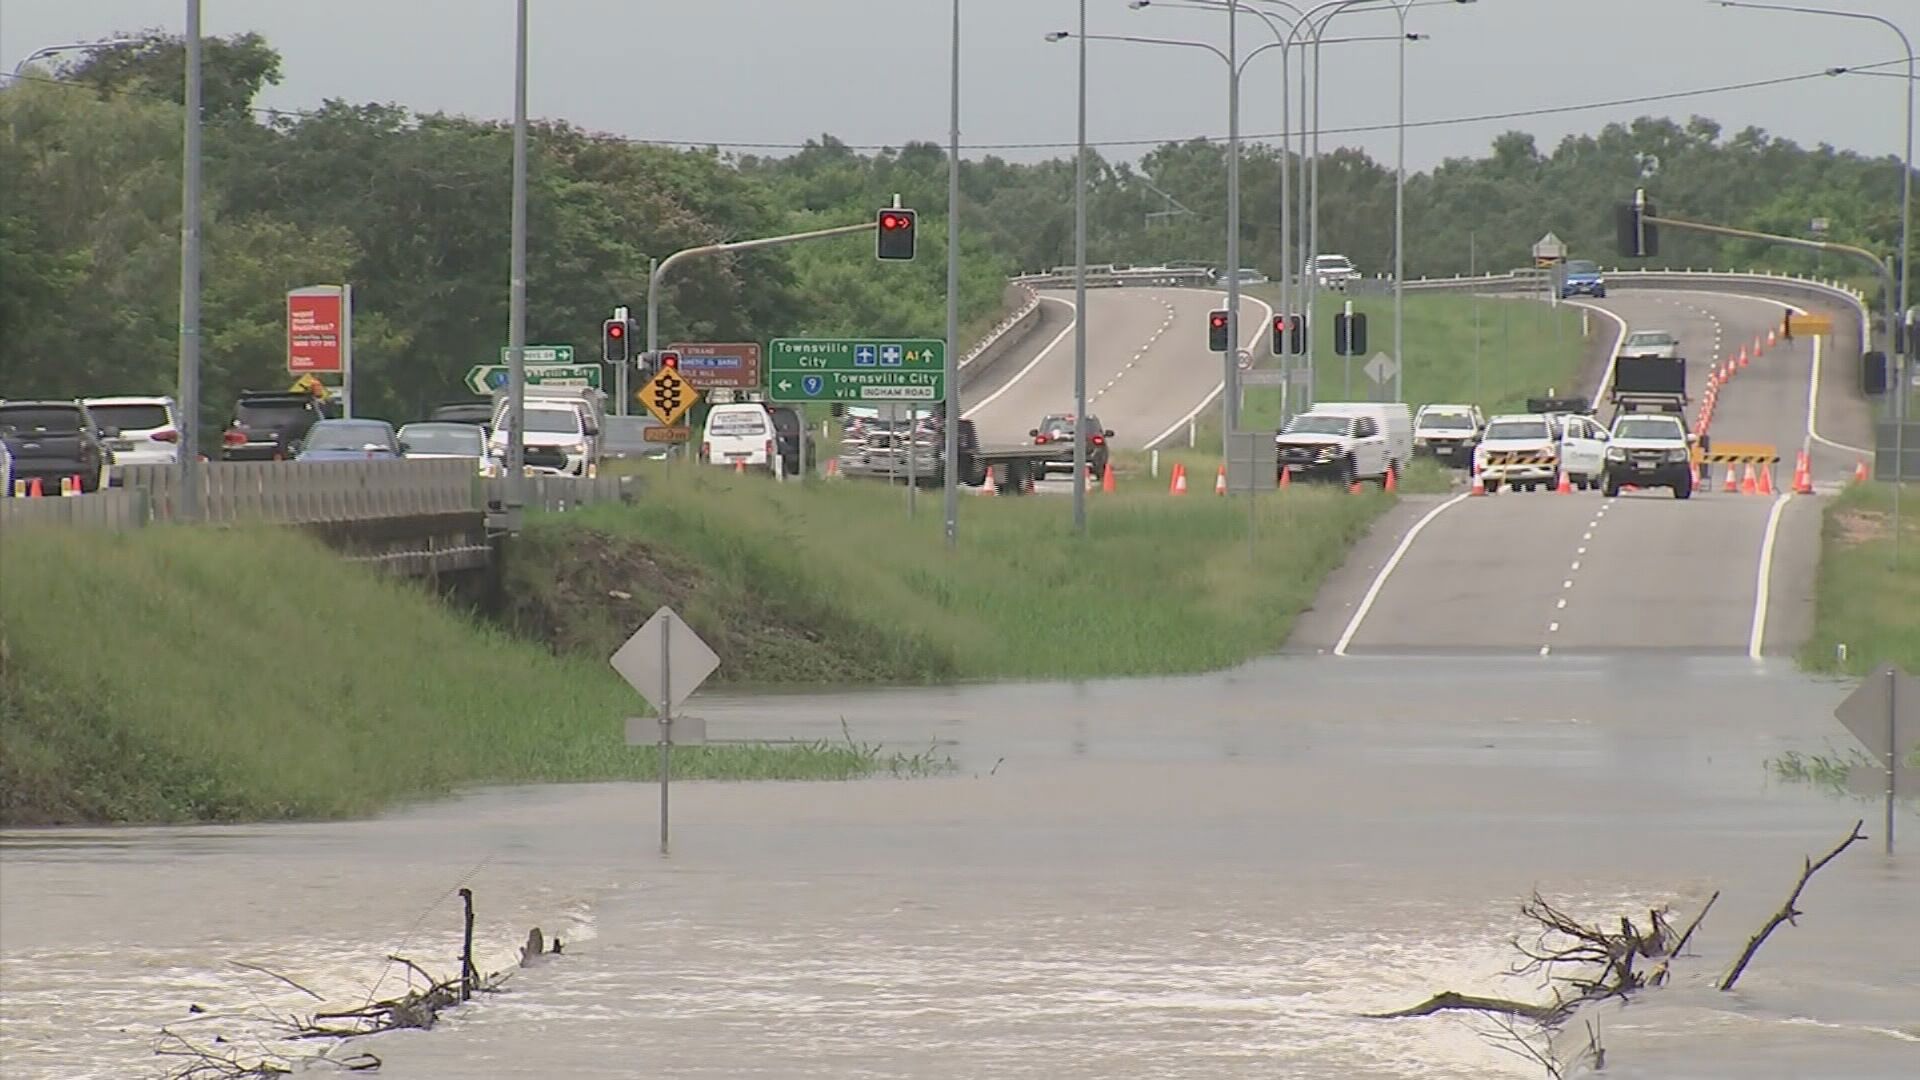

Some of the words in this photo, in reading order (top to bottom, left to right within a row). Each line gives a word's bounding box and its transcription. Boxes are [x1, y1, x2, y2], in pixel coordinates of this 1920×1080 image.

[777, 342, 849, 353] Townsville
[905, 351, 919, 361] A1
[799, 356, 827, 368] City
[808, 378, 817, 389] 9
[833, 372, 906, 384] Townsville
[909, 373, 938, 385] City
[835, 387, 857, 397] via
[863, 387, 902, 397] INGHAM
[905, 387, 931, 397] ROAD
